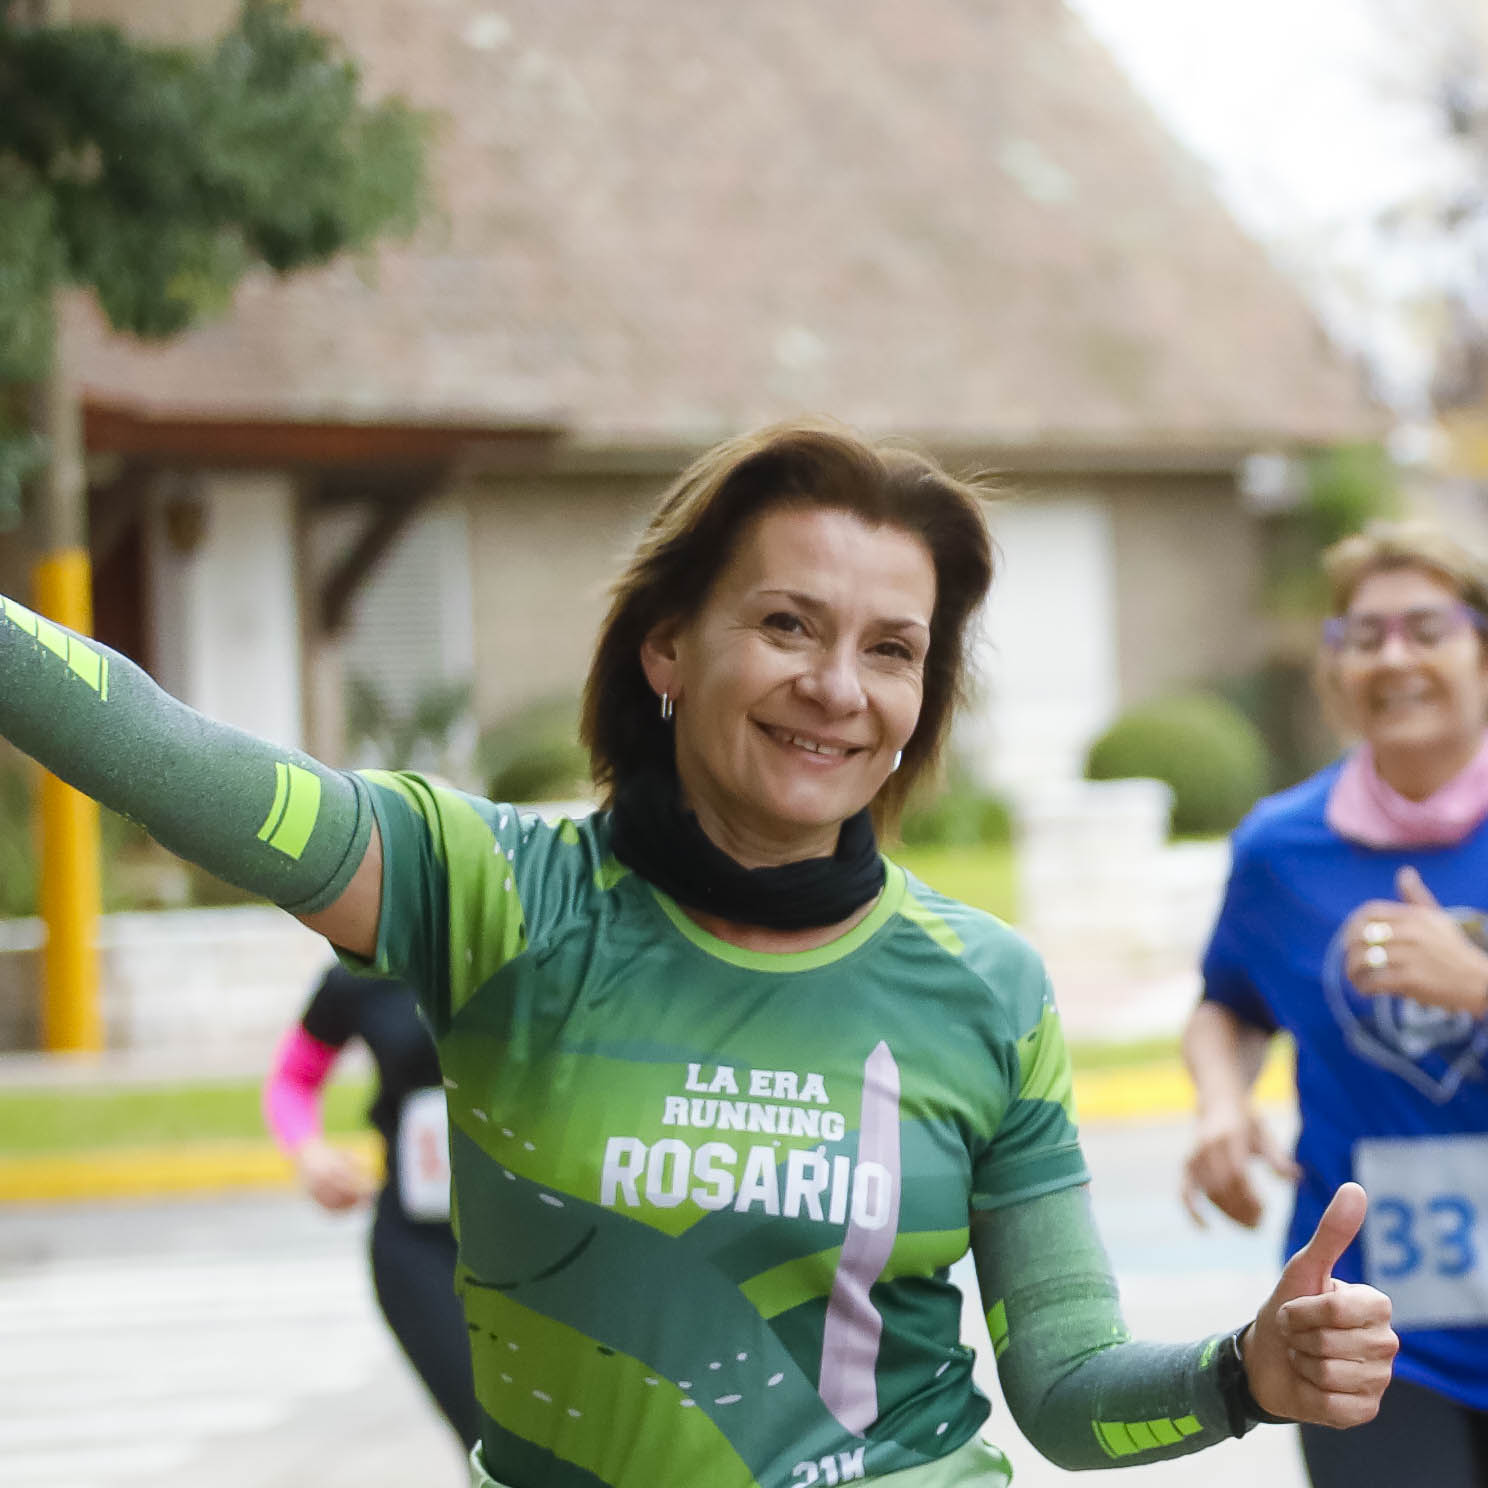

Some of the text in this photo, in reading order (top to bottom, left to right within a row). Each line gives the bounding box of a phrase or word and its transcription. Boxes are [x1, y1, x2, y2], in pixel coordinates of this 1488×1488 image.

[684, 1062, 830, 1105] LA ERA
[661, 1095, 846, 1142] RUNNING
[600, 1136, 892, 1230] ROSARIO
